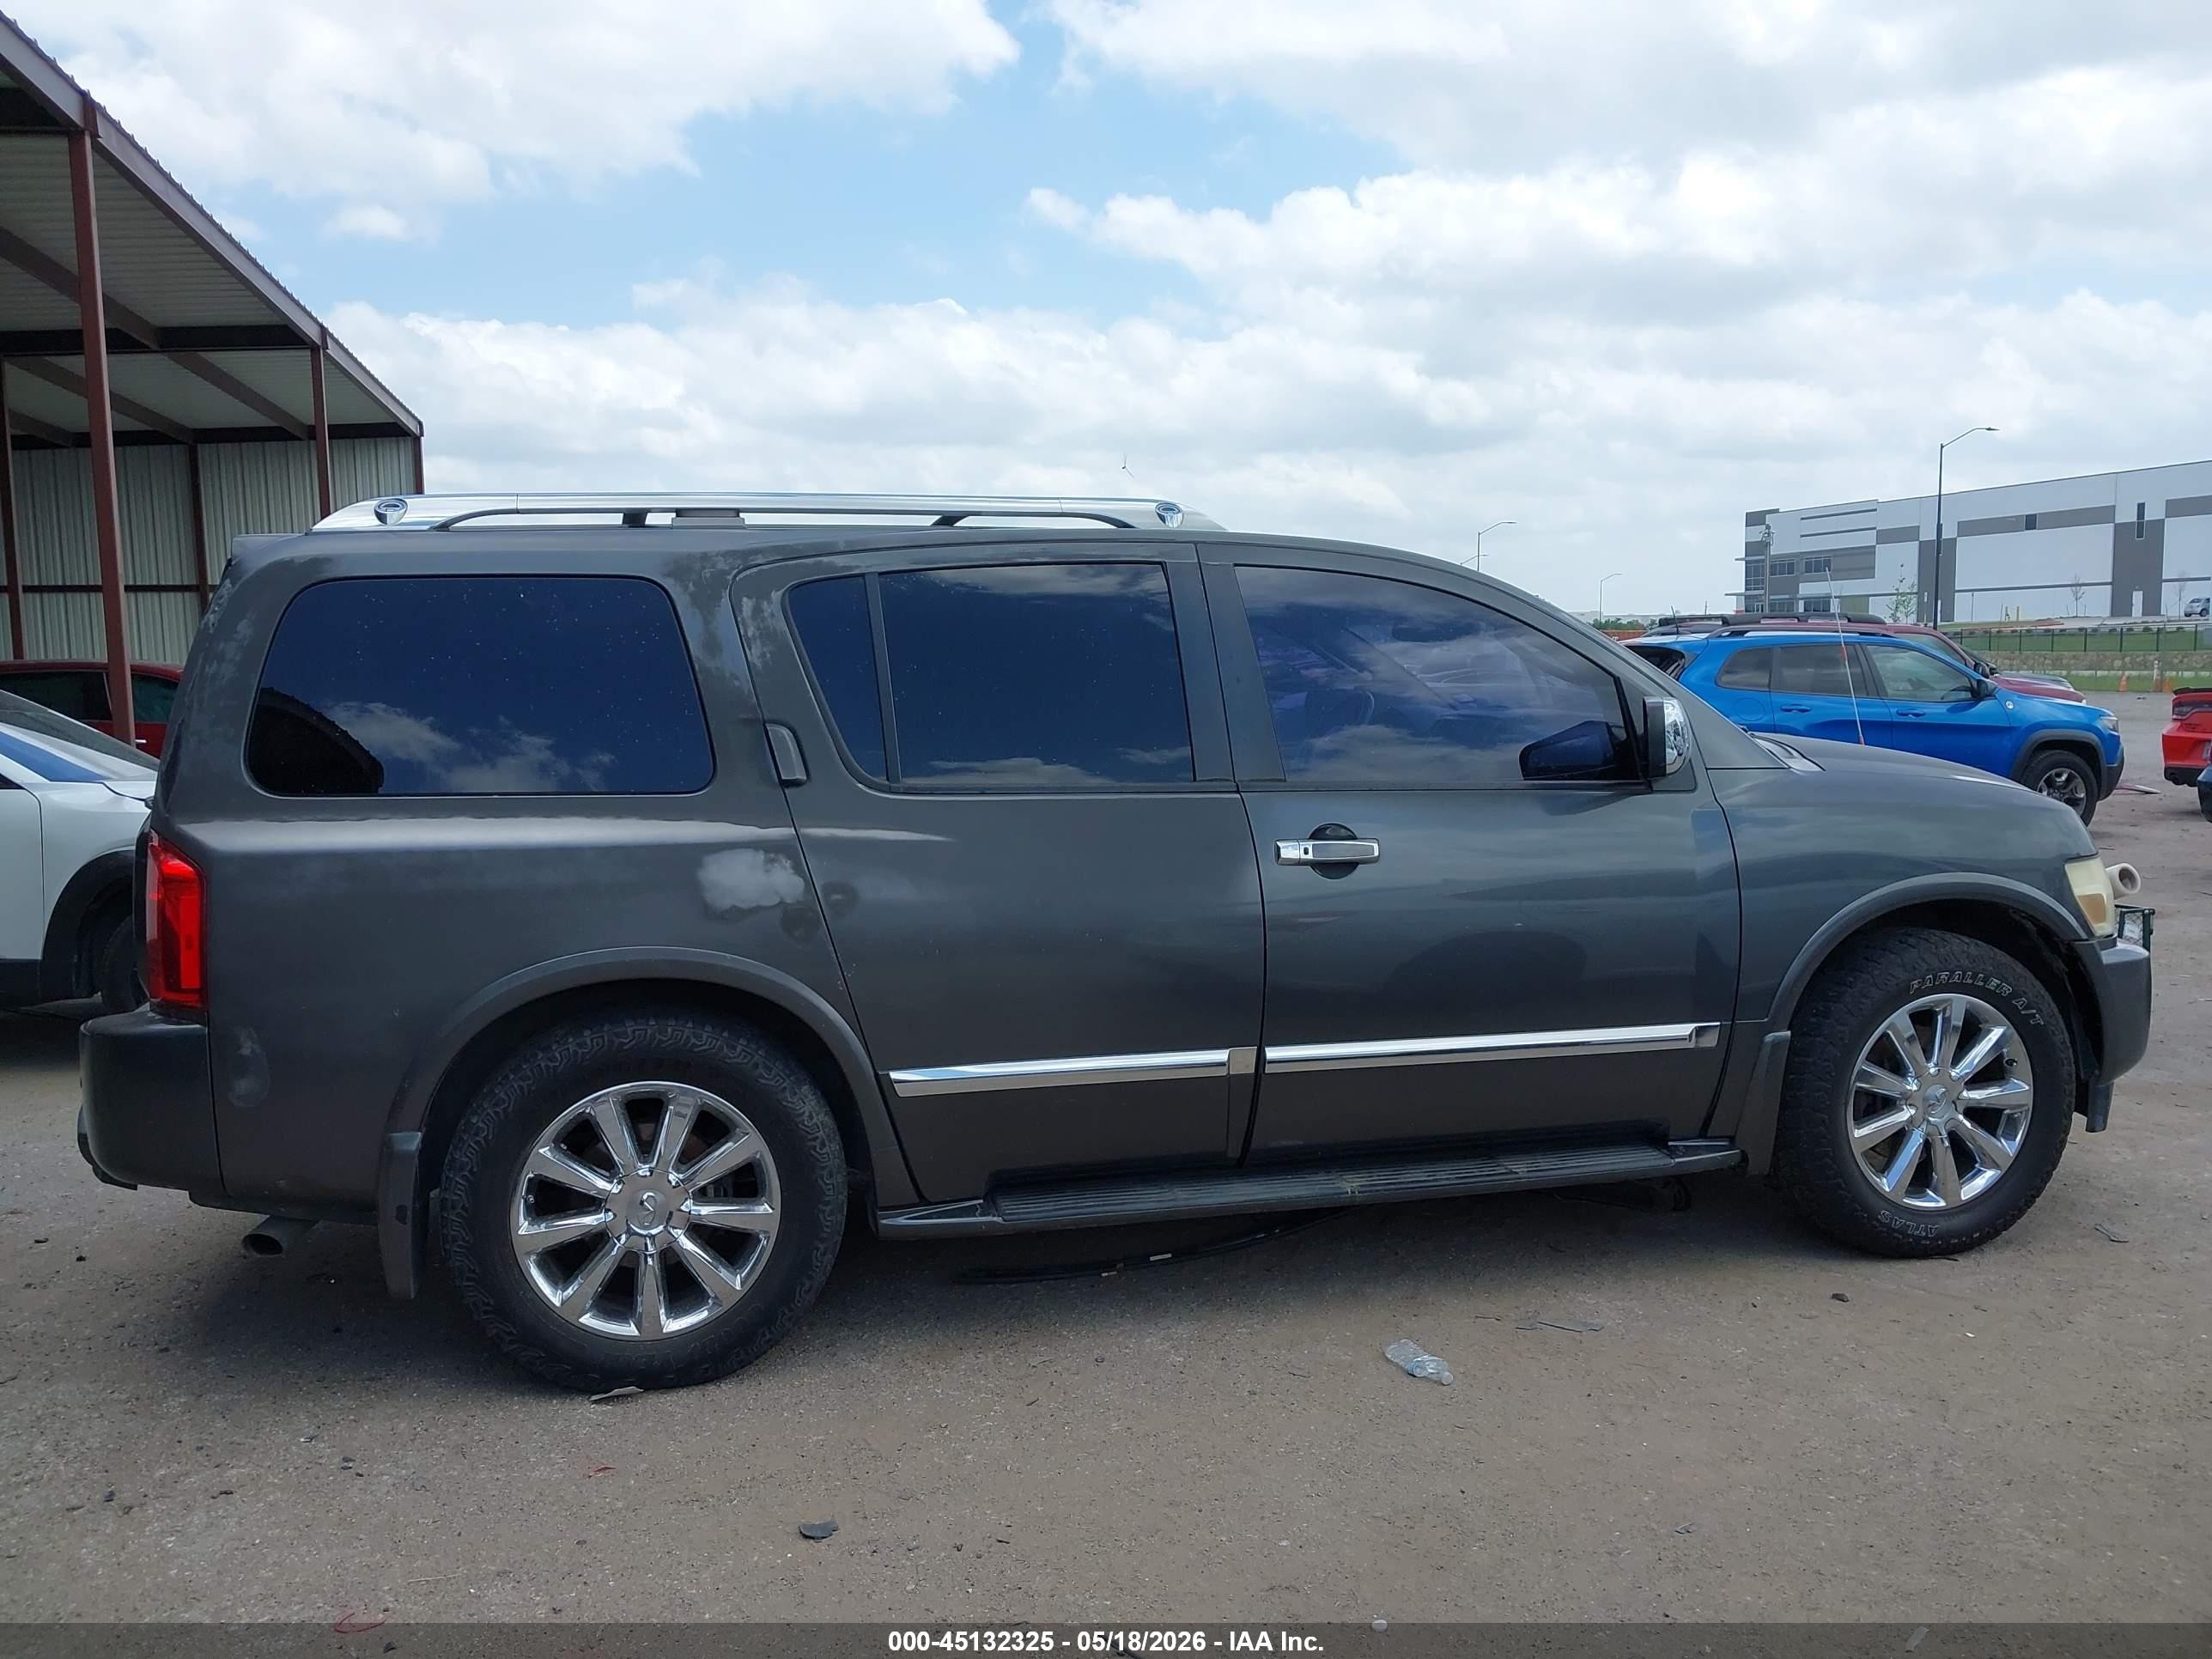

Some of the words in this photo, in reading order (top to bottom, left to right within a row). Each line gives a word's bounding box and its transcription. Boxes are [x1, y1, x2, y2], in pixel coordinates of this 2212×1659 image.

[1909, 970, 2013, 996] PARALLER
[2012, 997, 2045, 1025] A/T
[1878, 1209, 1940, 1237] ATLAS
